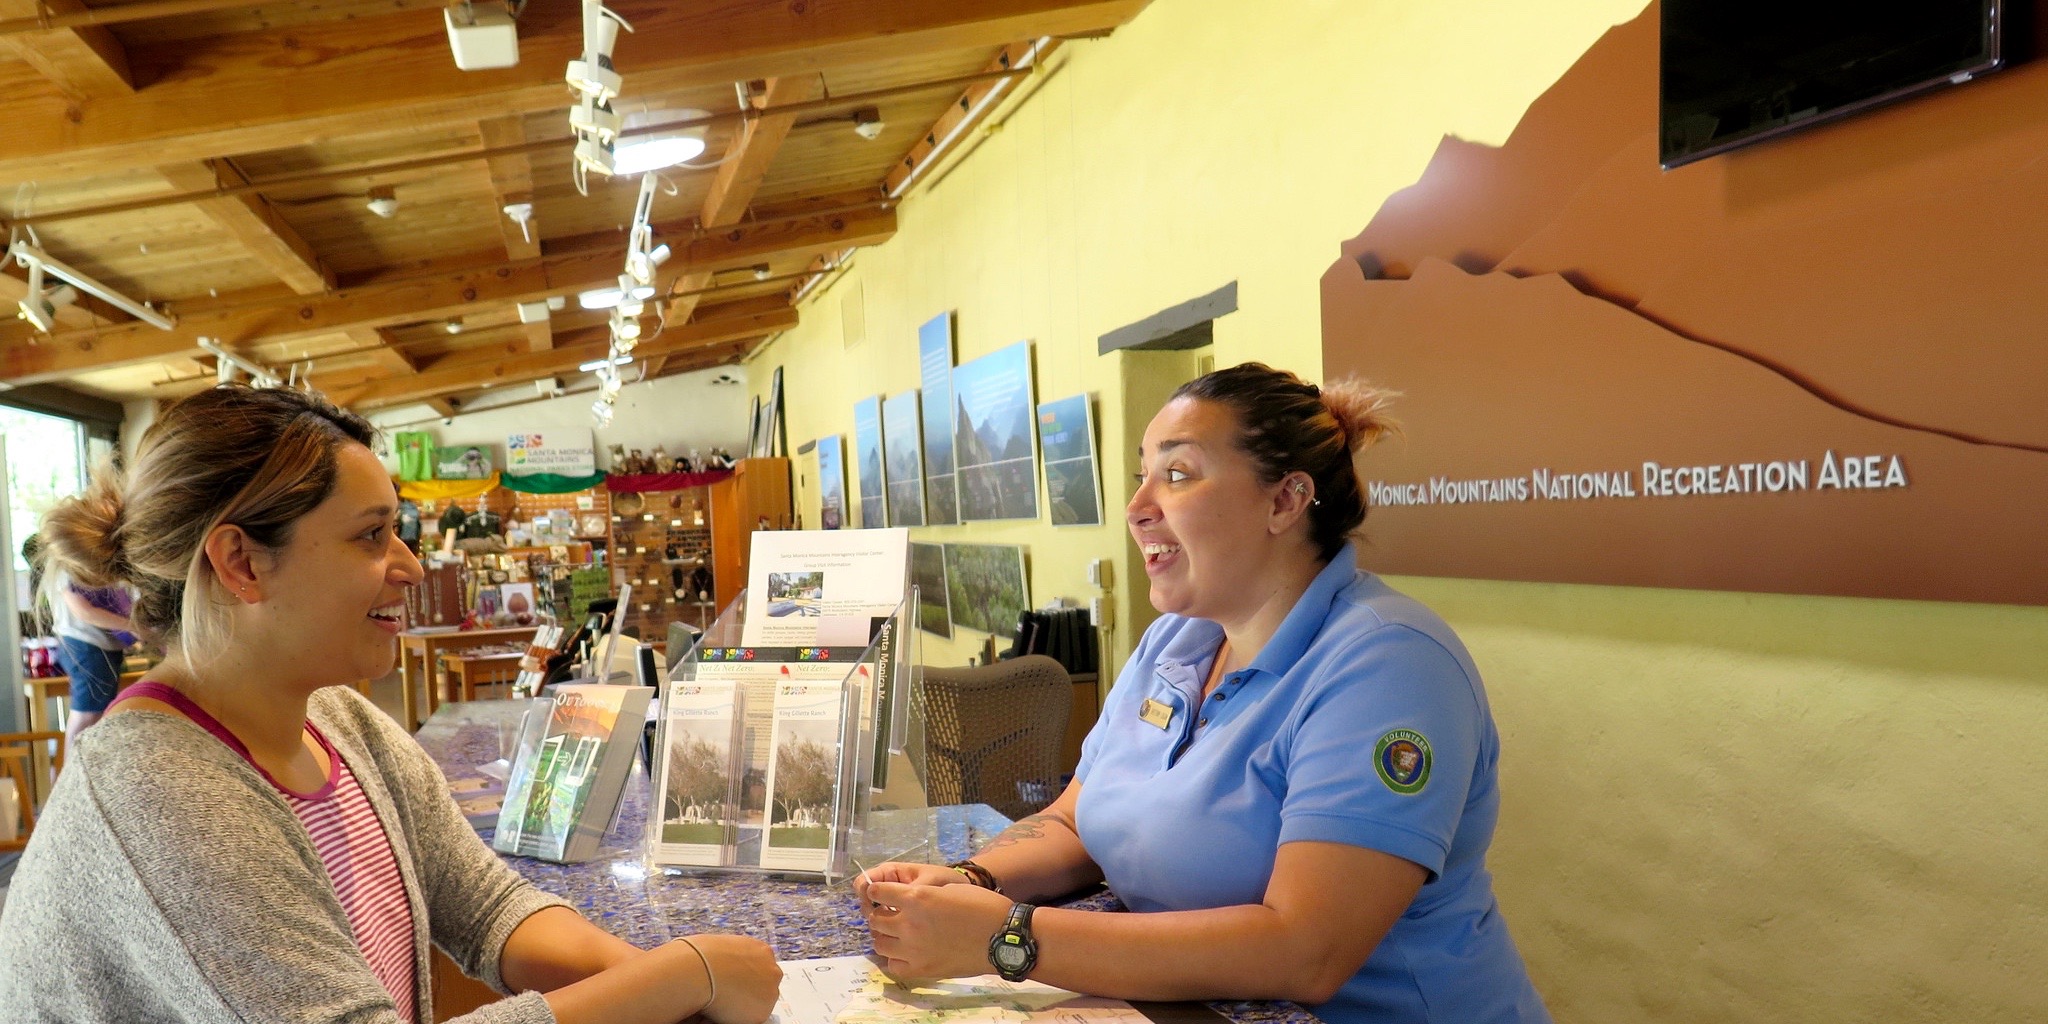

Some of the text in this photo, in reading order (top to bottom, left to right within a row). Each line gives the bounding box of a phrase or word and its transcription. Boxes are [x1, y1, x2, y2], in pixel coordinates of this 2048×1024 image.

[1368, 450, 1907, 506] MONICA MOUNTAINS NATIONAL RECREATION AREA
[880, 624, 892, 650] Santa
[720, 664, 735, 672] Net
[797, 664, 811, 672] Net
[877, 653, 889, 688] Monica
[673, 709, 685, 717] King
[1384, 731, 1428, 752] VOLUNTEER
